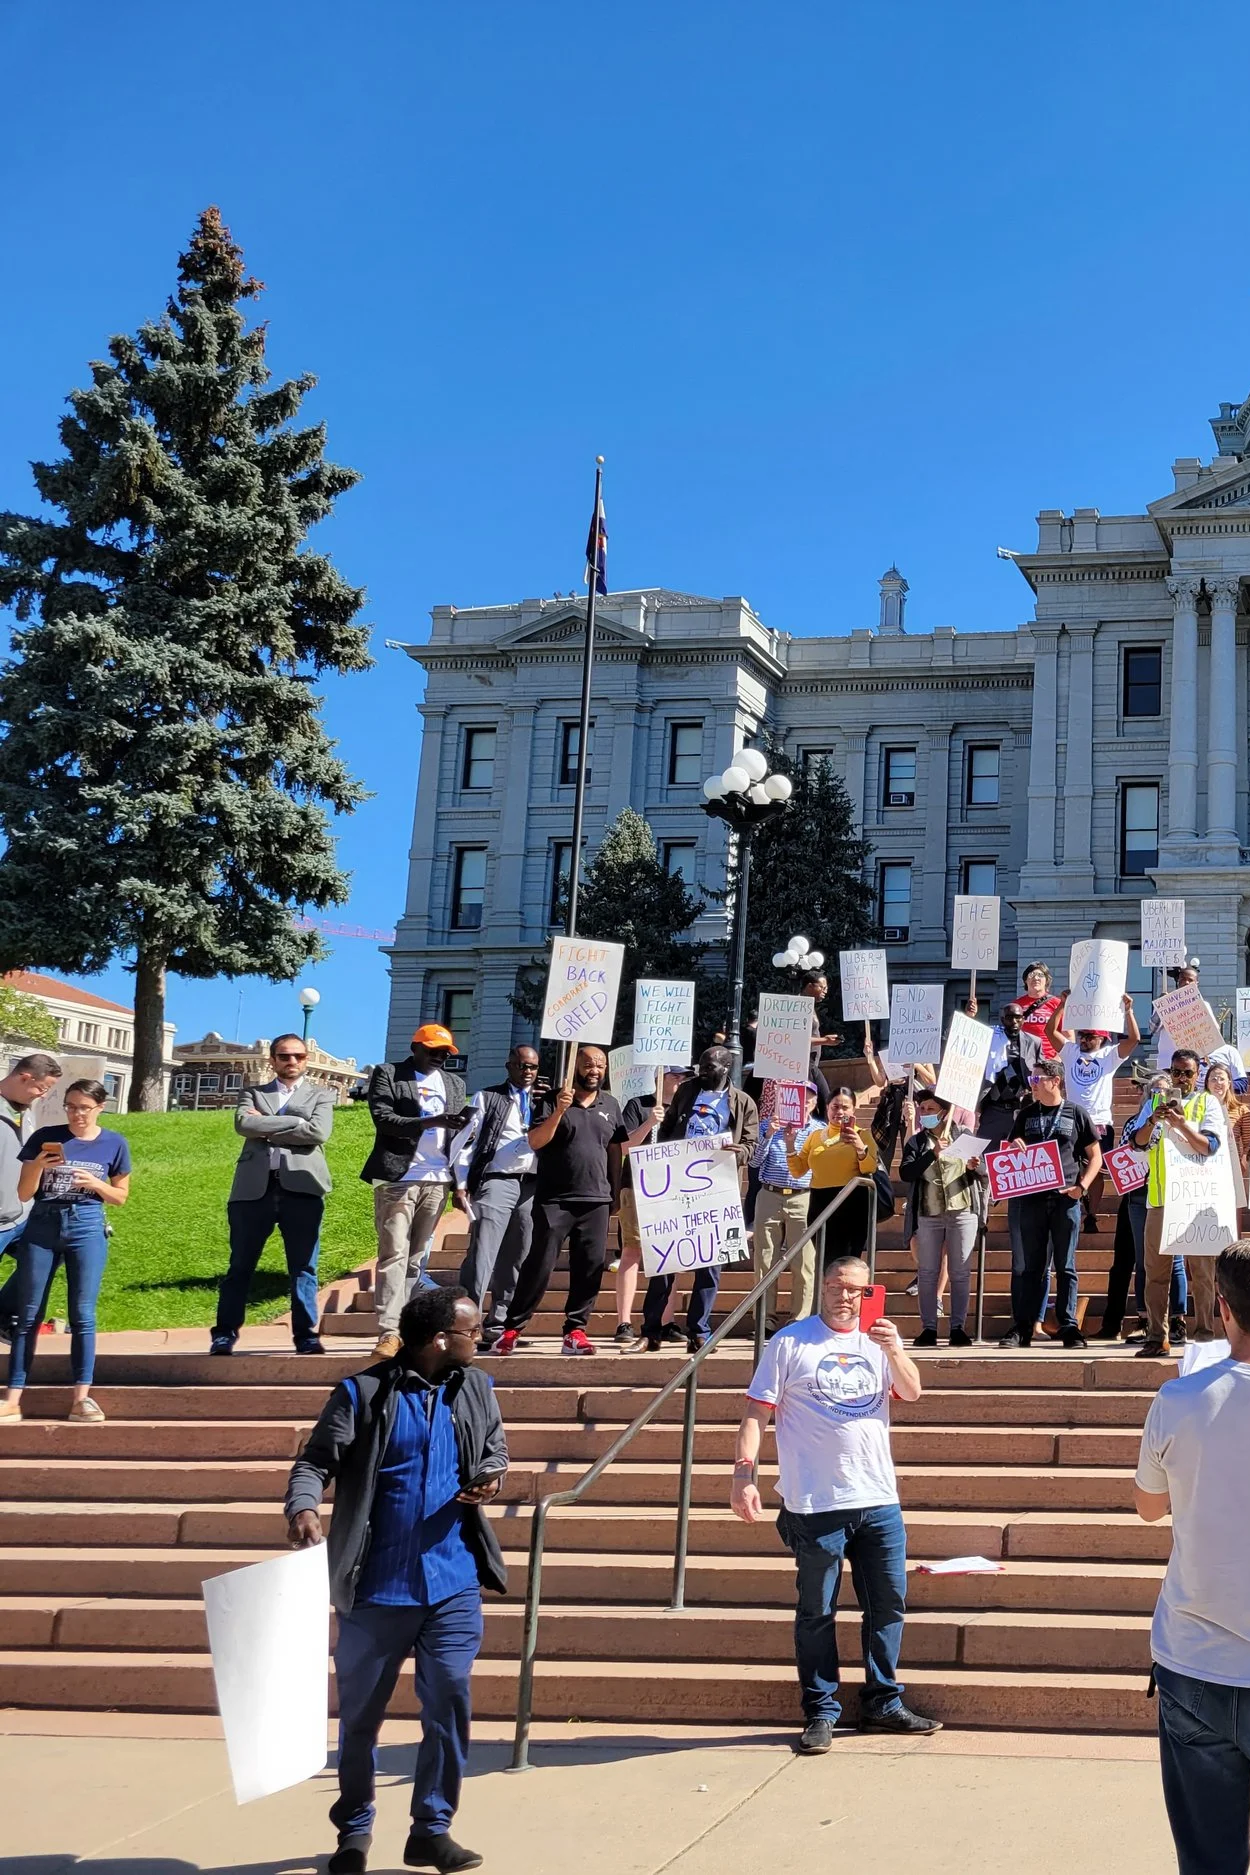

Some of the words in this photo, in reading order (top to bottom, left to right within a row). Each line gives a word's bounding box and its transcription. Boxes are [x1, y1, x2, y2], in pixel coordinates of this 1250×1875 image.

[956, 902, 993, 923] THE
[1145, 917, 1181, 929] TAKE
[956, 926, 990, 940] GIG
[1151, 930, 1170, 938] THE
[1143, 939, 1182, 949] MAJORITY
[558, 945, 610, 961] FIGHT
[956, 947, 969, 960] IS
[977, 946, 996, 960] UP!
[567, 966, 607, 983] BACK
[847, 964, 878, 977] LYFT
[641, 985, 661, 997] WE
[665, 986, 692, 998] WILL
[843, 977, 879, 992] STEAL
[547, 981, 589, 1017] CORPORATE
[896, 987, 926, 1003] END
[1155, 1001, 1164, 1009] WE
[1167, 993, 1183, 1004] HAVE
[1184, 988, 1195, 996] NO
[647, 1001, 686, 1012] FIGHT
[763, 997, 813, 1015] DRIVERS
[847, 1000, 882, 1016] FARES
[555, 992, 608, 1038] GREED
[636, 1014, 661, 1025] LIKE
[668, 1015, 692, 1026] HELL
[763, 1015, 807, 1030] UNITE!
[899, 1008, 924, 1024] BULL
[1165, 1017, 1174, 1025] WE
[1177, 1011, 1190, 1019] HAVE
[1192, 1005, 1200, 1013] NO
[650, 1027, 672, 1036] FOR
[767, 1032, 792, 1046] FOR
[636, 1037, 689, 1052] JUSTICE
[951, 1035, 978, 1058] AND
[757, 1043, 801, 1074] JUSTICE!
[622, 1078, 643, 1090] PASS
[631, 1142, 680, 1164] THERE'S
[686, 1139, 718, 1154] MORE
[993, 1148, 1052, 1174] CWA
[640, 1159, 714, 1198] US
[996, 1164, 1056, 1191] STRONG
[1171, 1181, 1218, 1201] DRIVE
[1185, 1202, 1218, 1217] THIS
[642, 1218, 679, 1237] THAN
[682, 1209, 718, 1228] THERE
[723, 1205, 742, 1221] ARE
[685, 1228, 696, 1236] OF
[651, 1224, 721, 1273] YOU!
